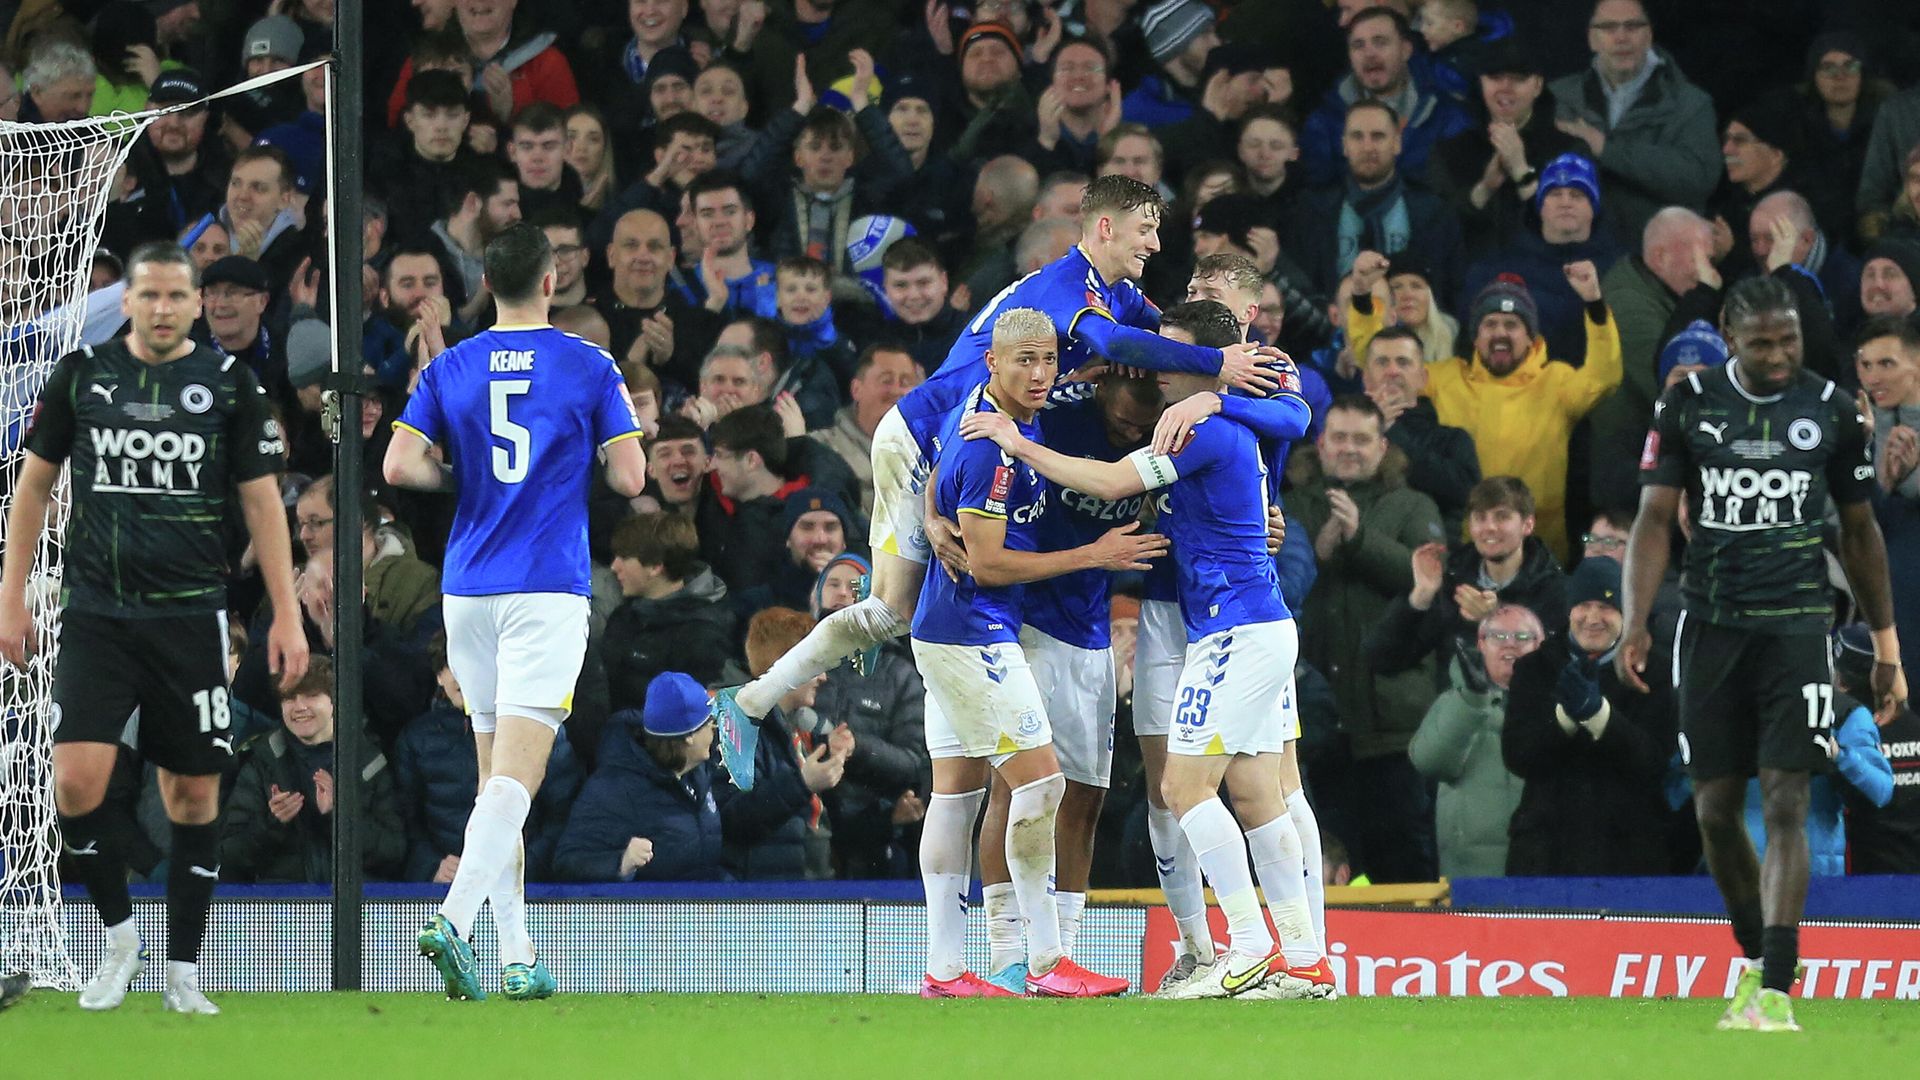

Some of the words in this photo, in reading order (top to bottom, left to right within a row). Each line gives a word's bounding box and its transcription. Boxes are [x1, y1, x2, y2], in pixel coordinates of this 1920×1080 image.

[490, 350, 536, 372] KEANE
[89, 427, 206, 463] WOOD
[490, 380, 531, 484] 5
[94, 456, 203, 489] ARMY
[1061, 487, 1142, 520] CAZOO
[1700, 491, 1808, 526] ARMY
[192, 686, 231, 733] 18
[1176, 686, 1212, 727] 23
[1801, 682, 1833, 728] 17
[1170, 941, 1568, 997] irates
